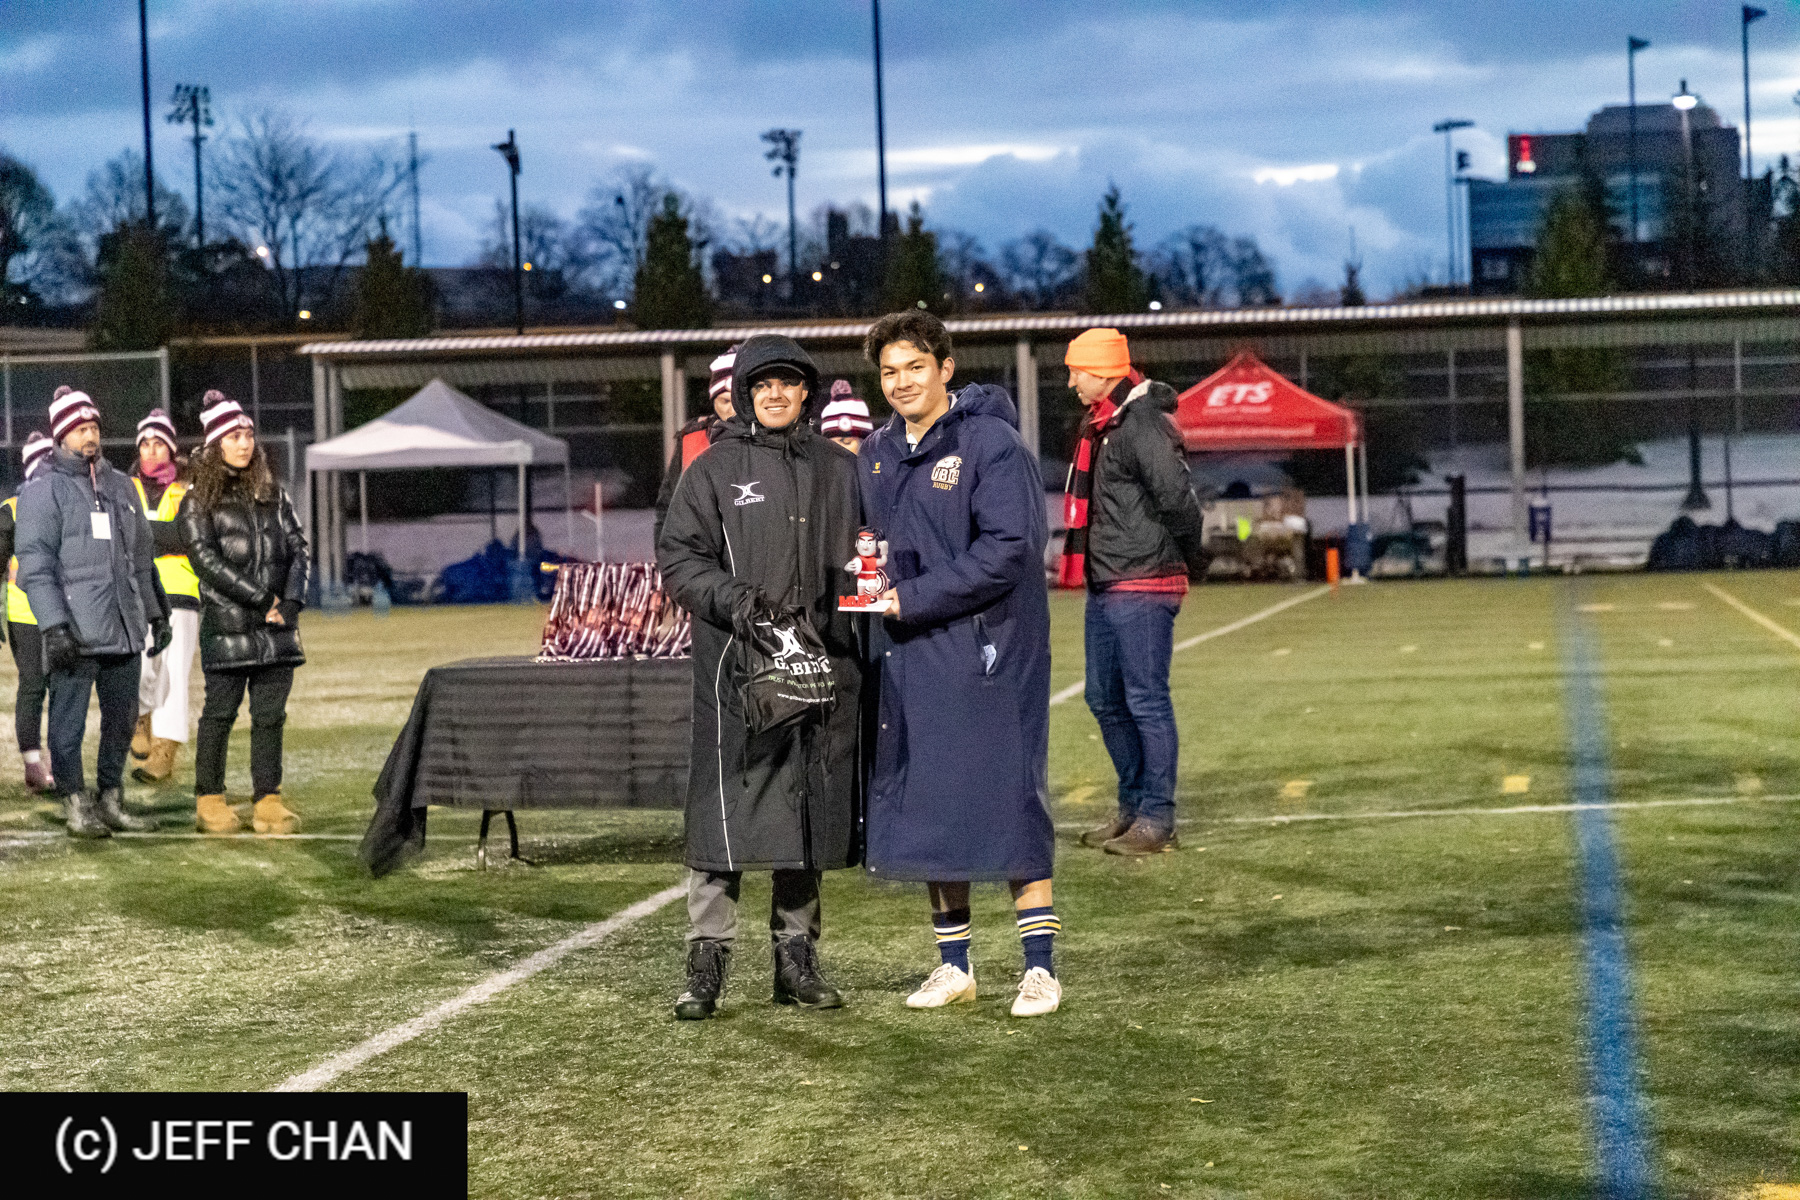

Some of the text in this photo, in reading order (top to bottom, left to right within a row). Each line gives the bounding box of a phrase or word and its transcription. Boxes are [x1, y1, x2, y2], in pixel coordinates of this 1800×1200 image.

[1206, 380, 1274, 407] ETS
[931, 467, 960, 485] UBC
[932, 481, 953, 490] RUGBY
[734, 496, 765, 506] GILBERT
[768, 675, 785, 684] TRUST
